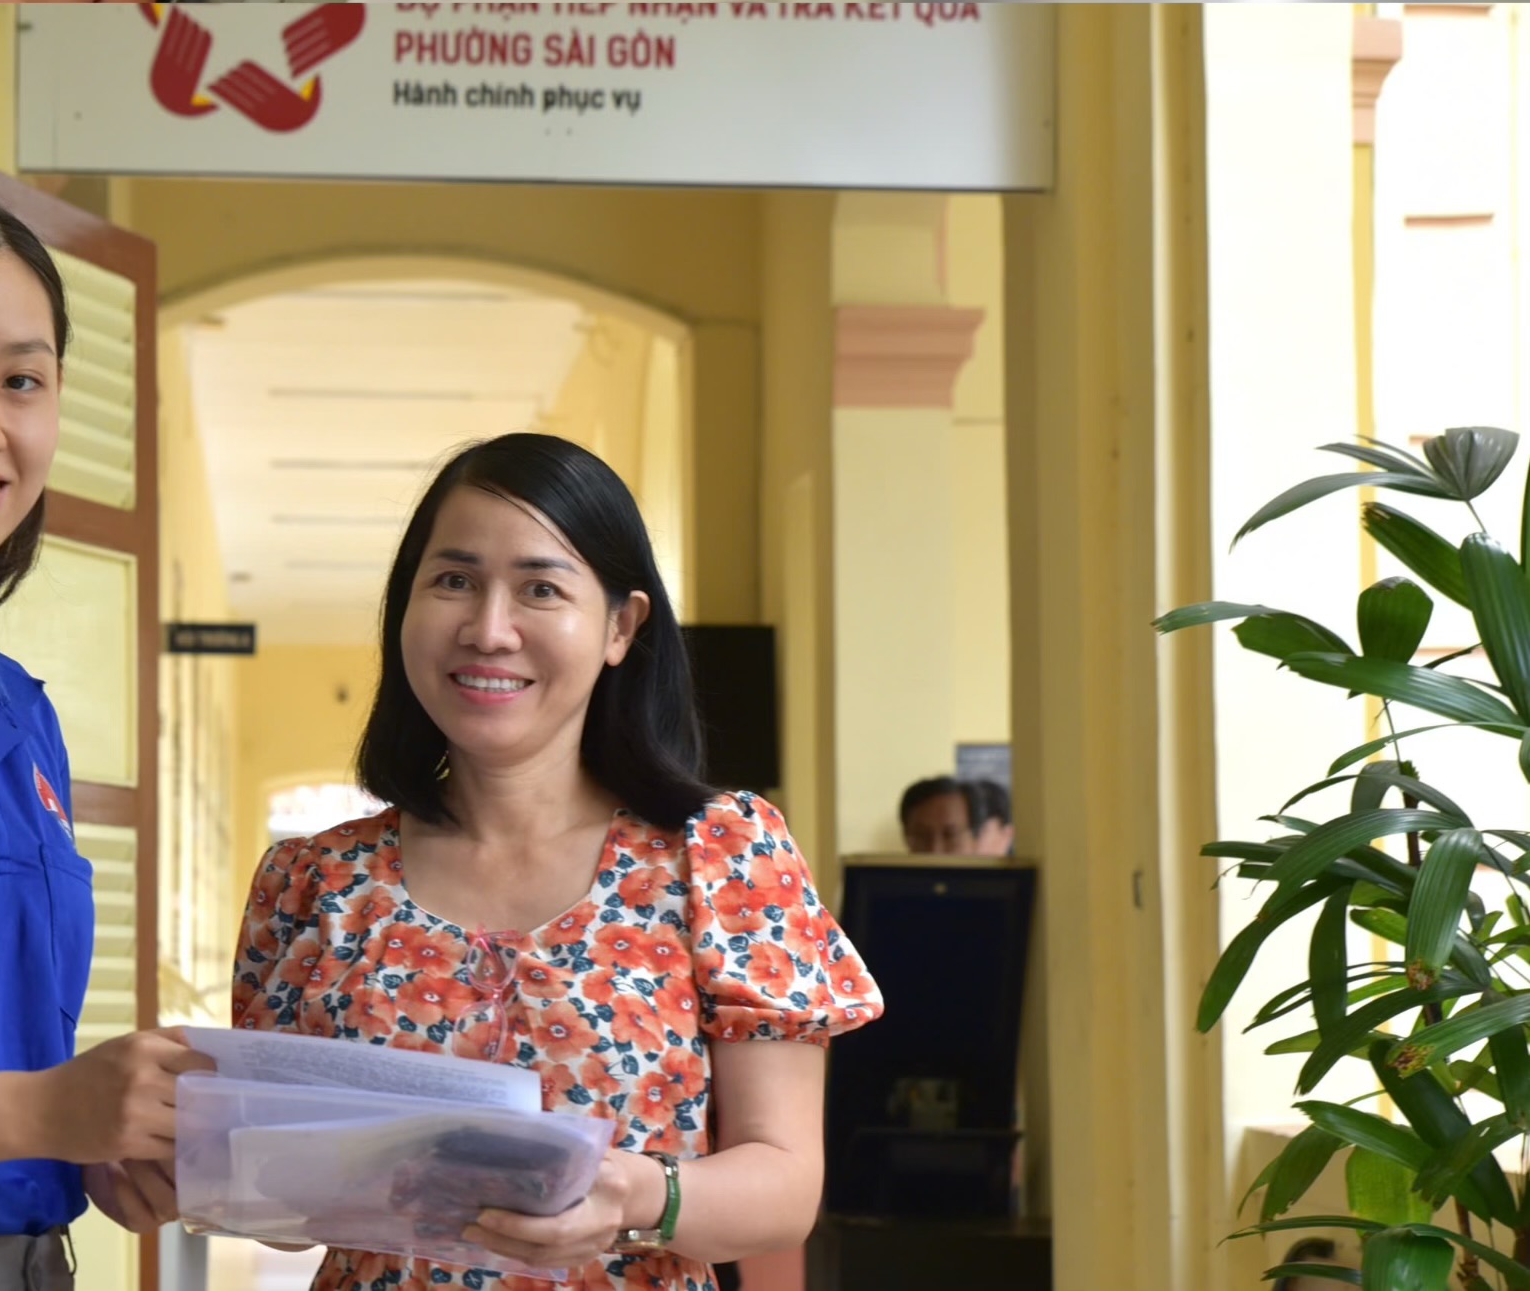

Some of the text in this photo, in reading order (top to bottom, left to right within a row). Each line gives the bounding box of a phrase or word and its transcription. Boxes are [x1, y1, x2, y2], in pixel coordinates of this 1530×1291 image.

[395, 26, 676, 68] PHƯỜNG SÀI GÒN
[393, 80, 641, 117] Hành chính phục vụ
